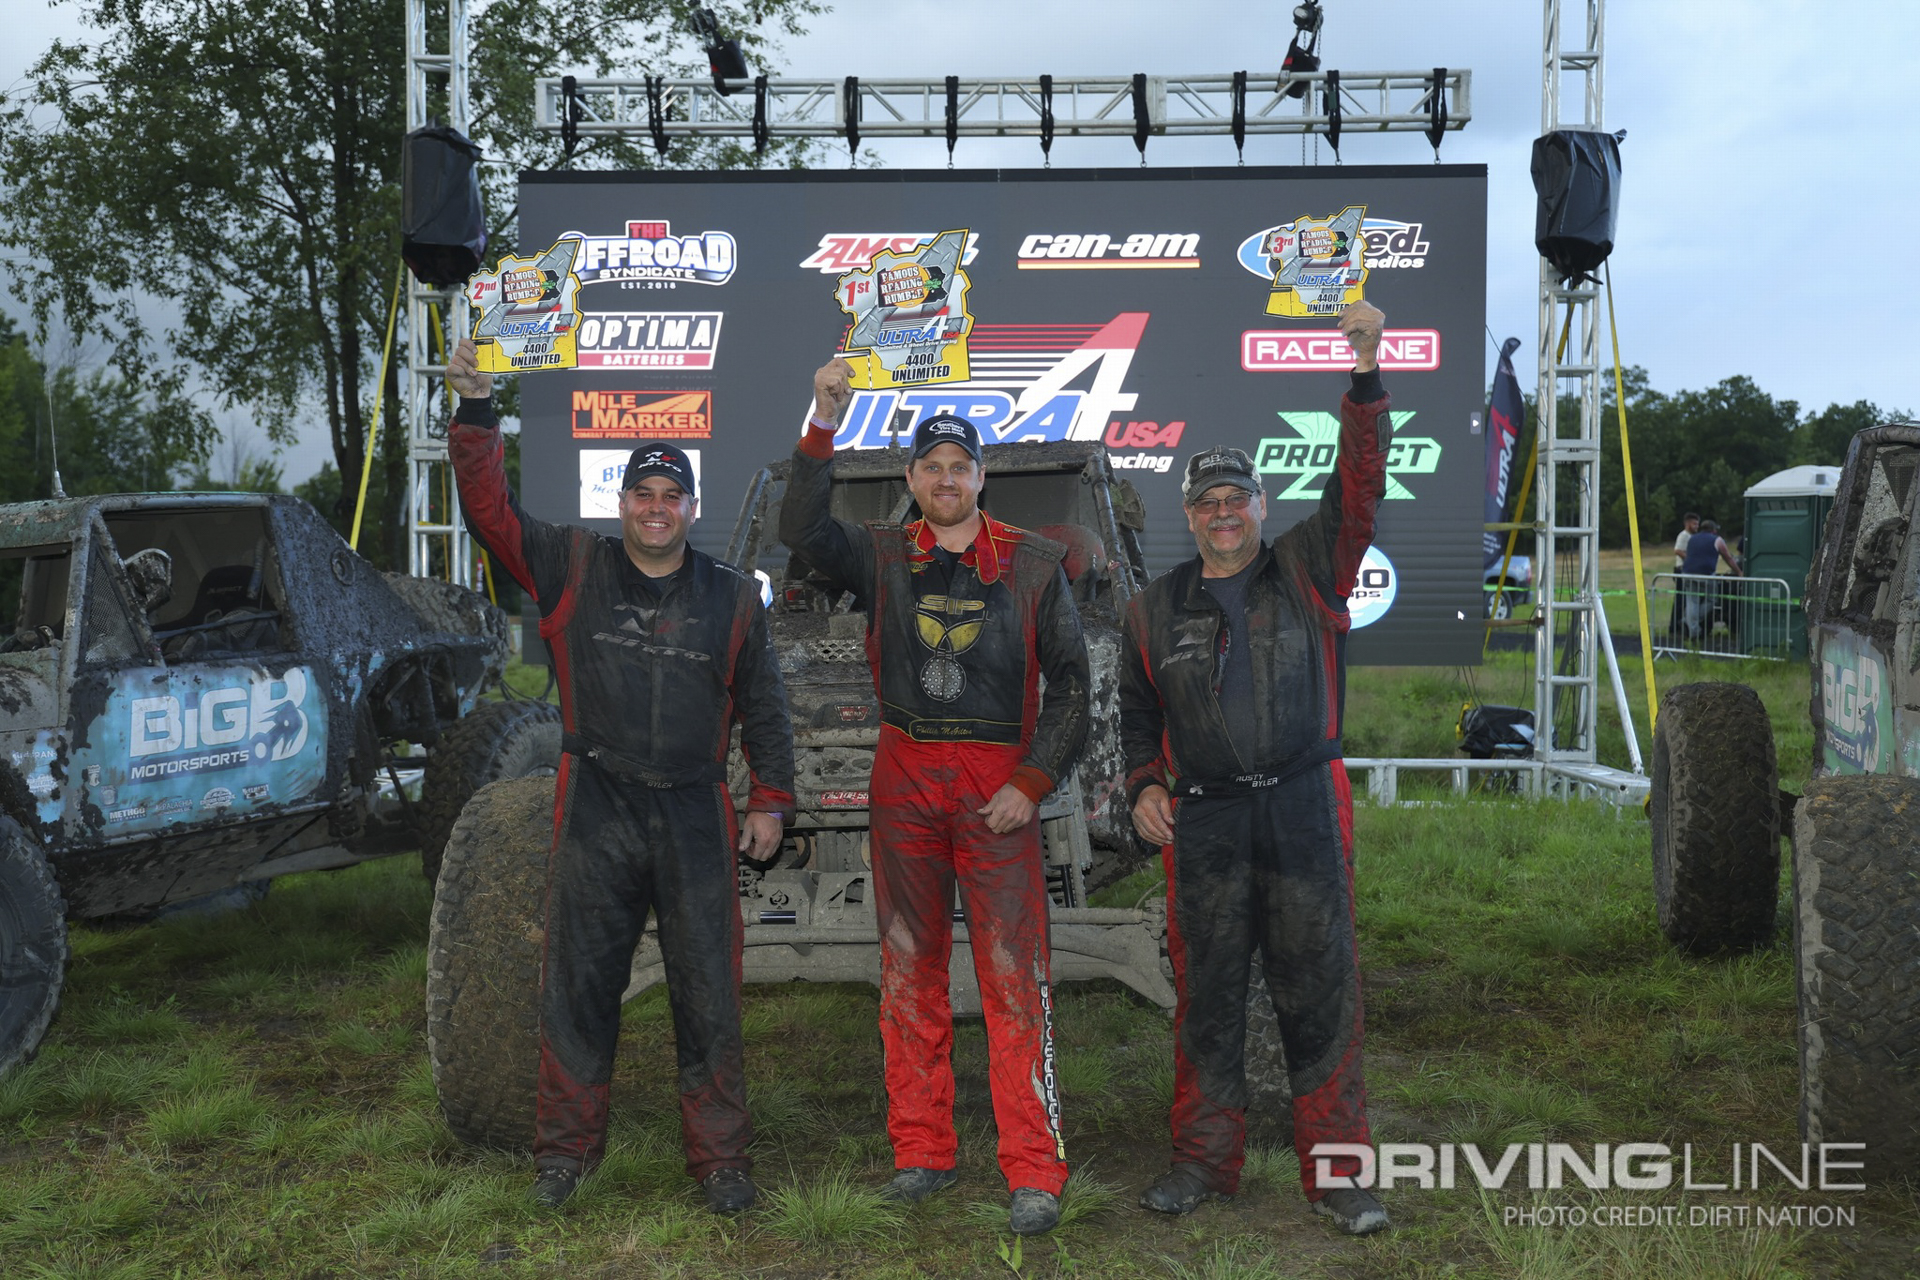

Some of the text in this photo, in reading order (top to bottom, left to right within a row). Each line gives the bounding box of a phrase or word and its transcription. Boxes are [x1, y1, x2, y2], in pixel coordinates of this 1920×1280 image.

[630, 224, 666, 238] THE
[1301, 229, 1330, 239] FAMOUS
[1273, 236, 1294, 254] 3rd
[1301, 238, 1333, 249] READING
[1302, 246, 1333, 257] RUMBLE
[1364, 256, 1425, 268] adios
[504, 269, 538, 282] FAMOUS
[599, 267, 696, 279] SYNDICATE
[881, 265, 920, 283] FAMOUS
[473, 281, 497, 300] 2nd
[503, 278, 540, 292] READING
[880, 277, 924, 294] READING
[506, 287, 541, 301] RUMBLE
[844, 280, 871, 306] 1st
[884, 288, 925, 305] RUMBLE
[1317, 293, 1339, 303] 4400
[579, 319, 711, 347] OPTIMA
[523, 343, 548, 354] 4400
[510, 353, 561, 367] UNLIMITED
[602, 354, 685, 366] BATTERIES
[905, 353, 935, 366] 4400
[891, 365, 951, 382] UNLIMITED
[573, 391, 637, 411] MILE
[592, 409, 707, 429] MARKER
[1104, 421, 1186, 448] USA
[638, 461, 683, 472] NITTO
[1108, 452, 1174, 473] acing
[919, 595, 985, 615] SIP
[131, 750, 250, 779] MOTORSPORTS
[1236, 773, 1264, 783] RUSTY
[1252, 777, 1279, 788] BYLER
